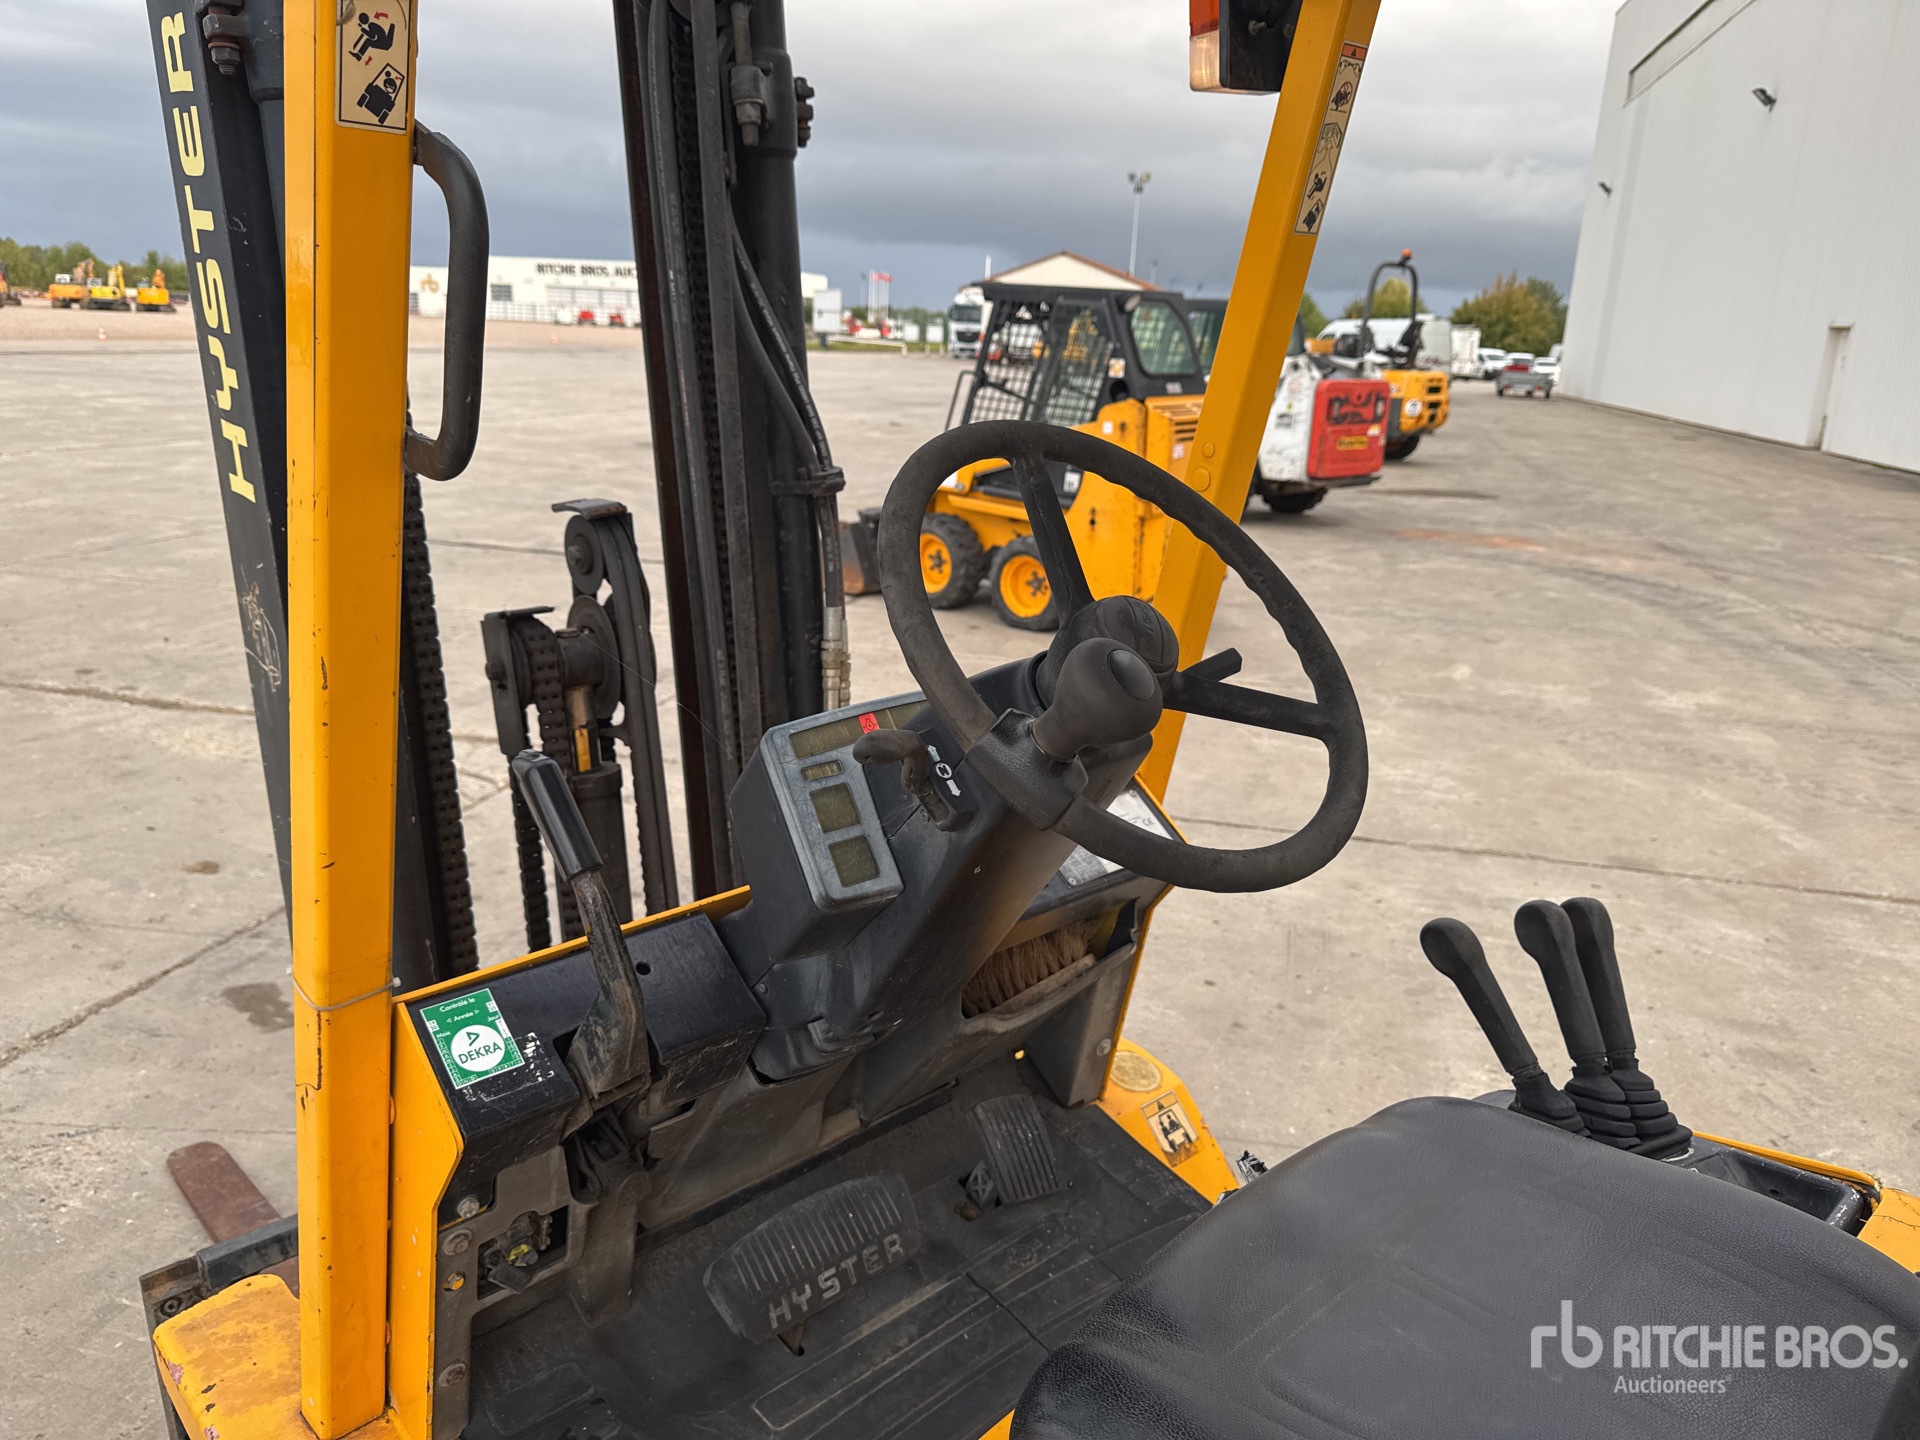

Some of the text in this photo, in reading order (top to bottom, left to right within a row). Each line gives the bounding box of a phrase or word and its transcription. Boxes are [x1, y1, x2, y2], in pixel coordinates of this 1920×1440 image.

[160, 11, 256, 504] HYSTER
[536, 263, 576, 276] RITCHIE
[436, 1031, 451, 1039] Mois
[458, 1042, 503, 1065] DEKRA
[769, 1232, 906, 1329] HYSTER
